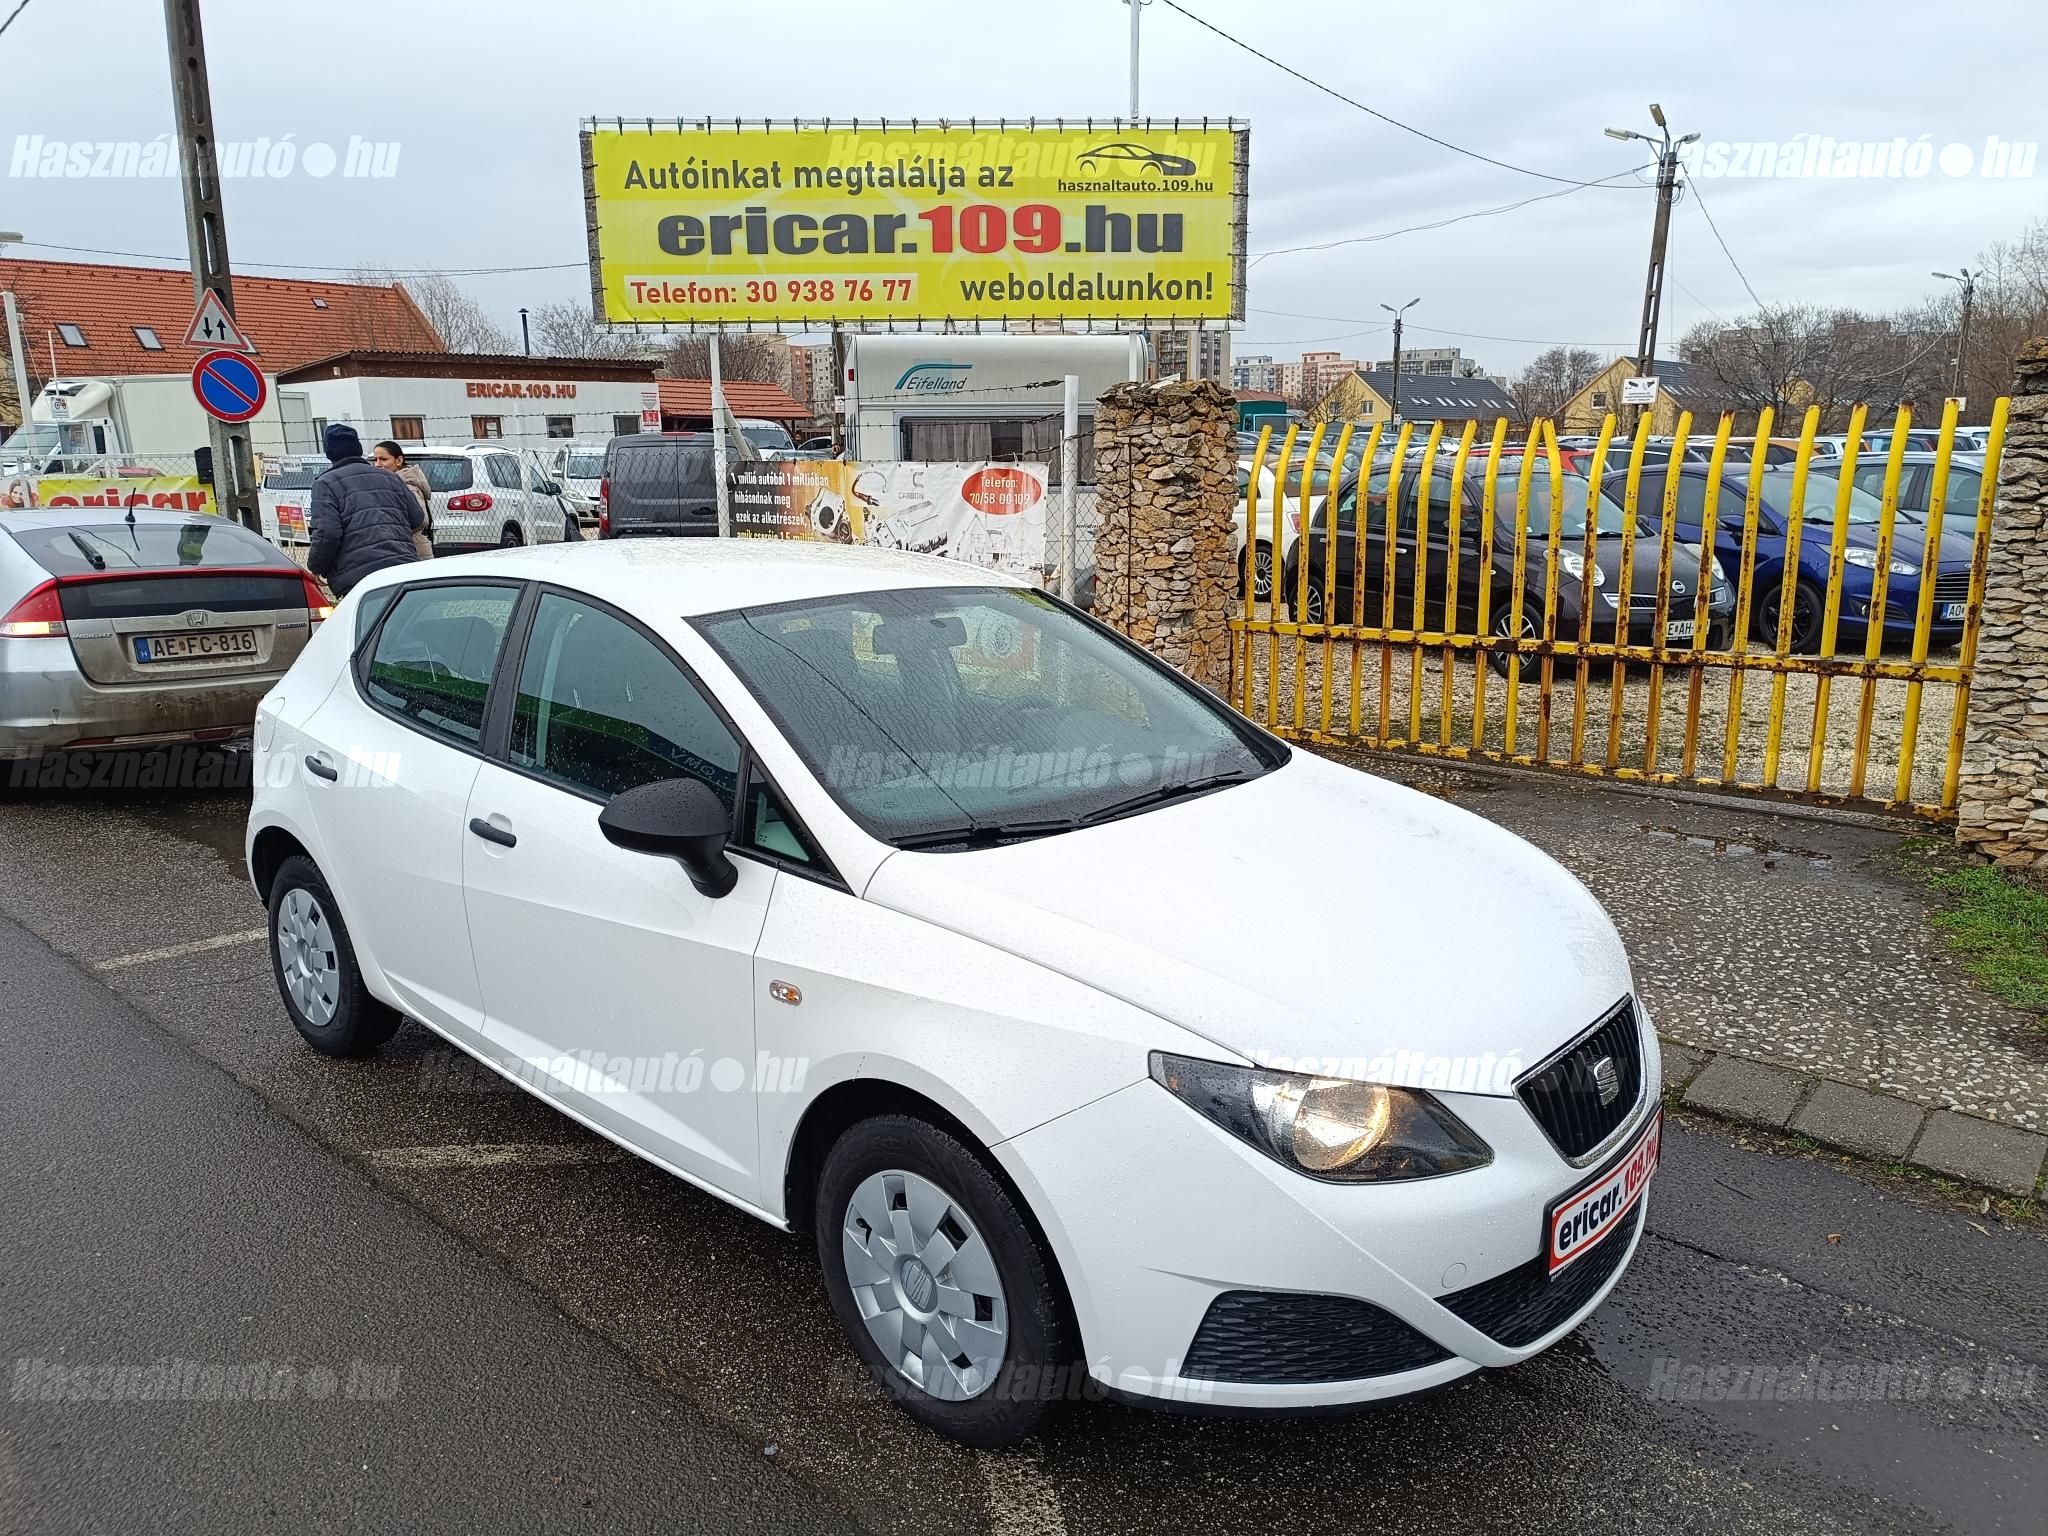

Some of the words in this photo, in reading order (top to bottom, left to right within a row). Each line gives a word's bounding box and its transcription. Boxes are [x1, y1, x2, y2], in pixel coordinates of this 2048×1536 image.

[624, 156, 781, 190] Autóinkat
[794, 154, 965, 196] megtalálja
[978, 165, 1014, 188] az
[1057, 179, 1214, 192] hasznaltauto.109.hu
[658, 204, 1183, 256] ericar.109.hu
[630, 281, 737, 304] Telefon:
[746, 280, 777, 303] 30
[787, 280, 835, 303] 938
[844, 280, 873, 302] 76
[882, 279, 912, 302] 77
[960, 272, 1213, 301] weboldalunkon!
[466, 383, 576, 399] ERICAR.109.HU
[906, 376, 968, 390] Eifelland
[737, 470, 756, 485] millió
[758, 471, 785, 486] autóból
[787, 472, 791, 486] 1
[792, 472, 829, 487] millióban
[980, 476, 1019, 488] Telefon:
[735, 490, 772, 504] hibásodnak
[774, 495, 791, 508] meg
[899, 492, 924, 500] CARBON
[735, 510, 751, 523] ezek
[752, 513, 760, 523] az
[761, 511, 807, 528] alkatrészek,
[154, 638, 179, 657] AE
[187, 633, 252, 654] FC-816
